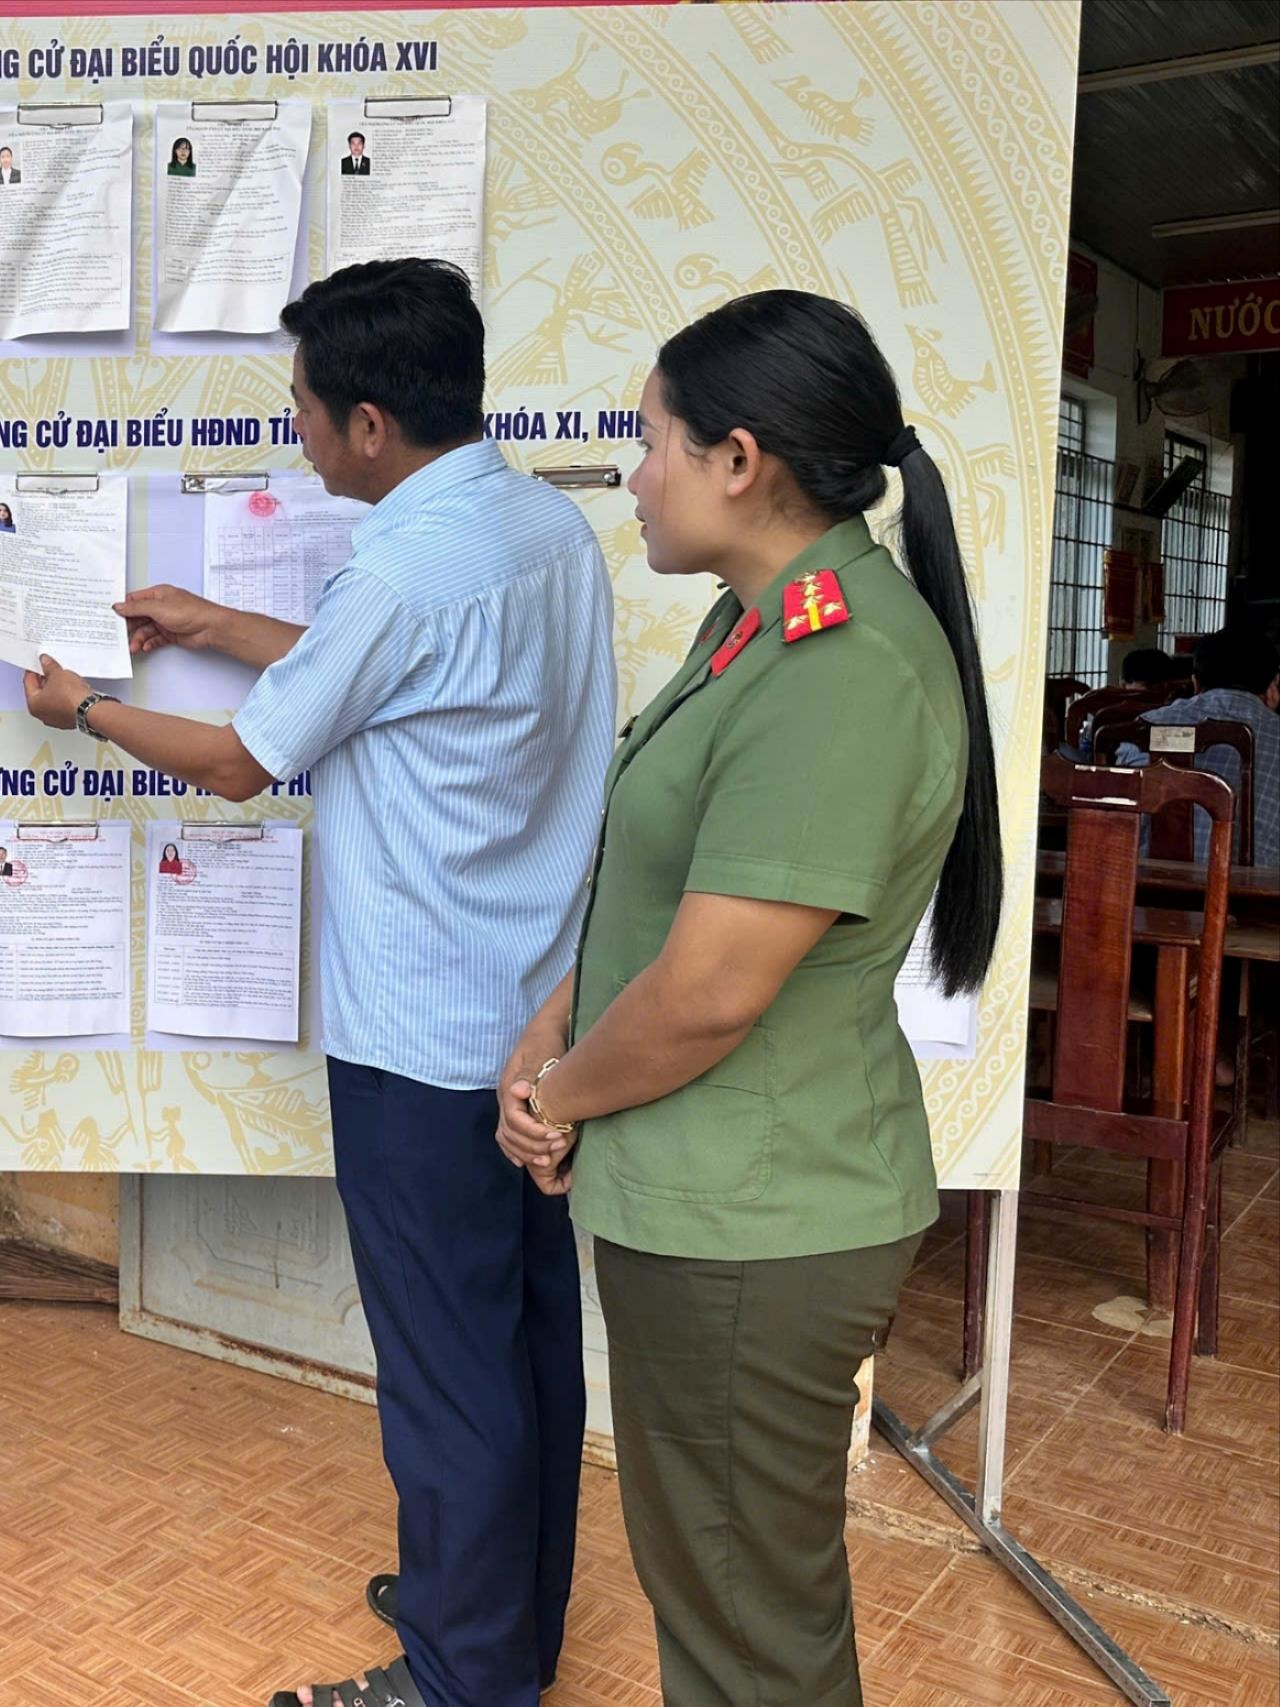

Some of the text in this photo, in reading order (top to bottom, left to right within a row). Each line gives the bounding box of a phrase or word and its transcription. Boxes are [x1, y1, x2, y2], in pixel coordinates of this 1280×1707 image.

[28, 38, 65, 79] CỬ
[69, 48, 113, 85] ĐẠI
[121, 34, 180, 77] BIỂU
[188, 34, 257, 79] QUỐC
[266, 37, 309, 81] HỘI
[317, 36, 388, 73] KHÓA
[395, 41, 437, 71] XVI
[1187, 292, 1280, 341] NƯỚC
[35, 410, 72, 449] CỬ
[75, 419, 118, 454] ĐẠI
[126, 407, 183, 447] BIỂU
[191, 417, 261, 446] HĐND
[483, 406, 548, 441] KHÓA
[554, 411, 589, 443] XI,
[43, 760, 79, 797] CỬ
[82, 769, 124, 803] ĐẠI
